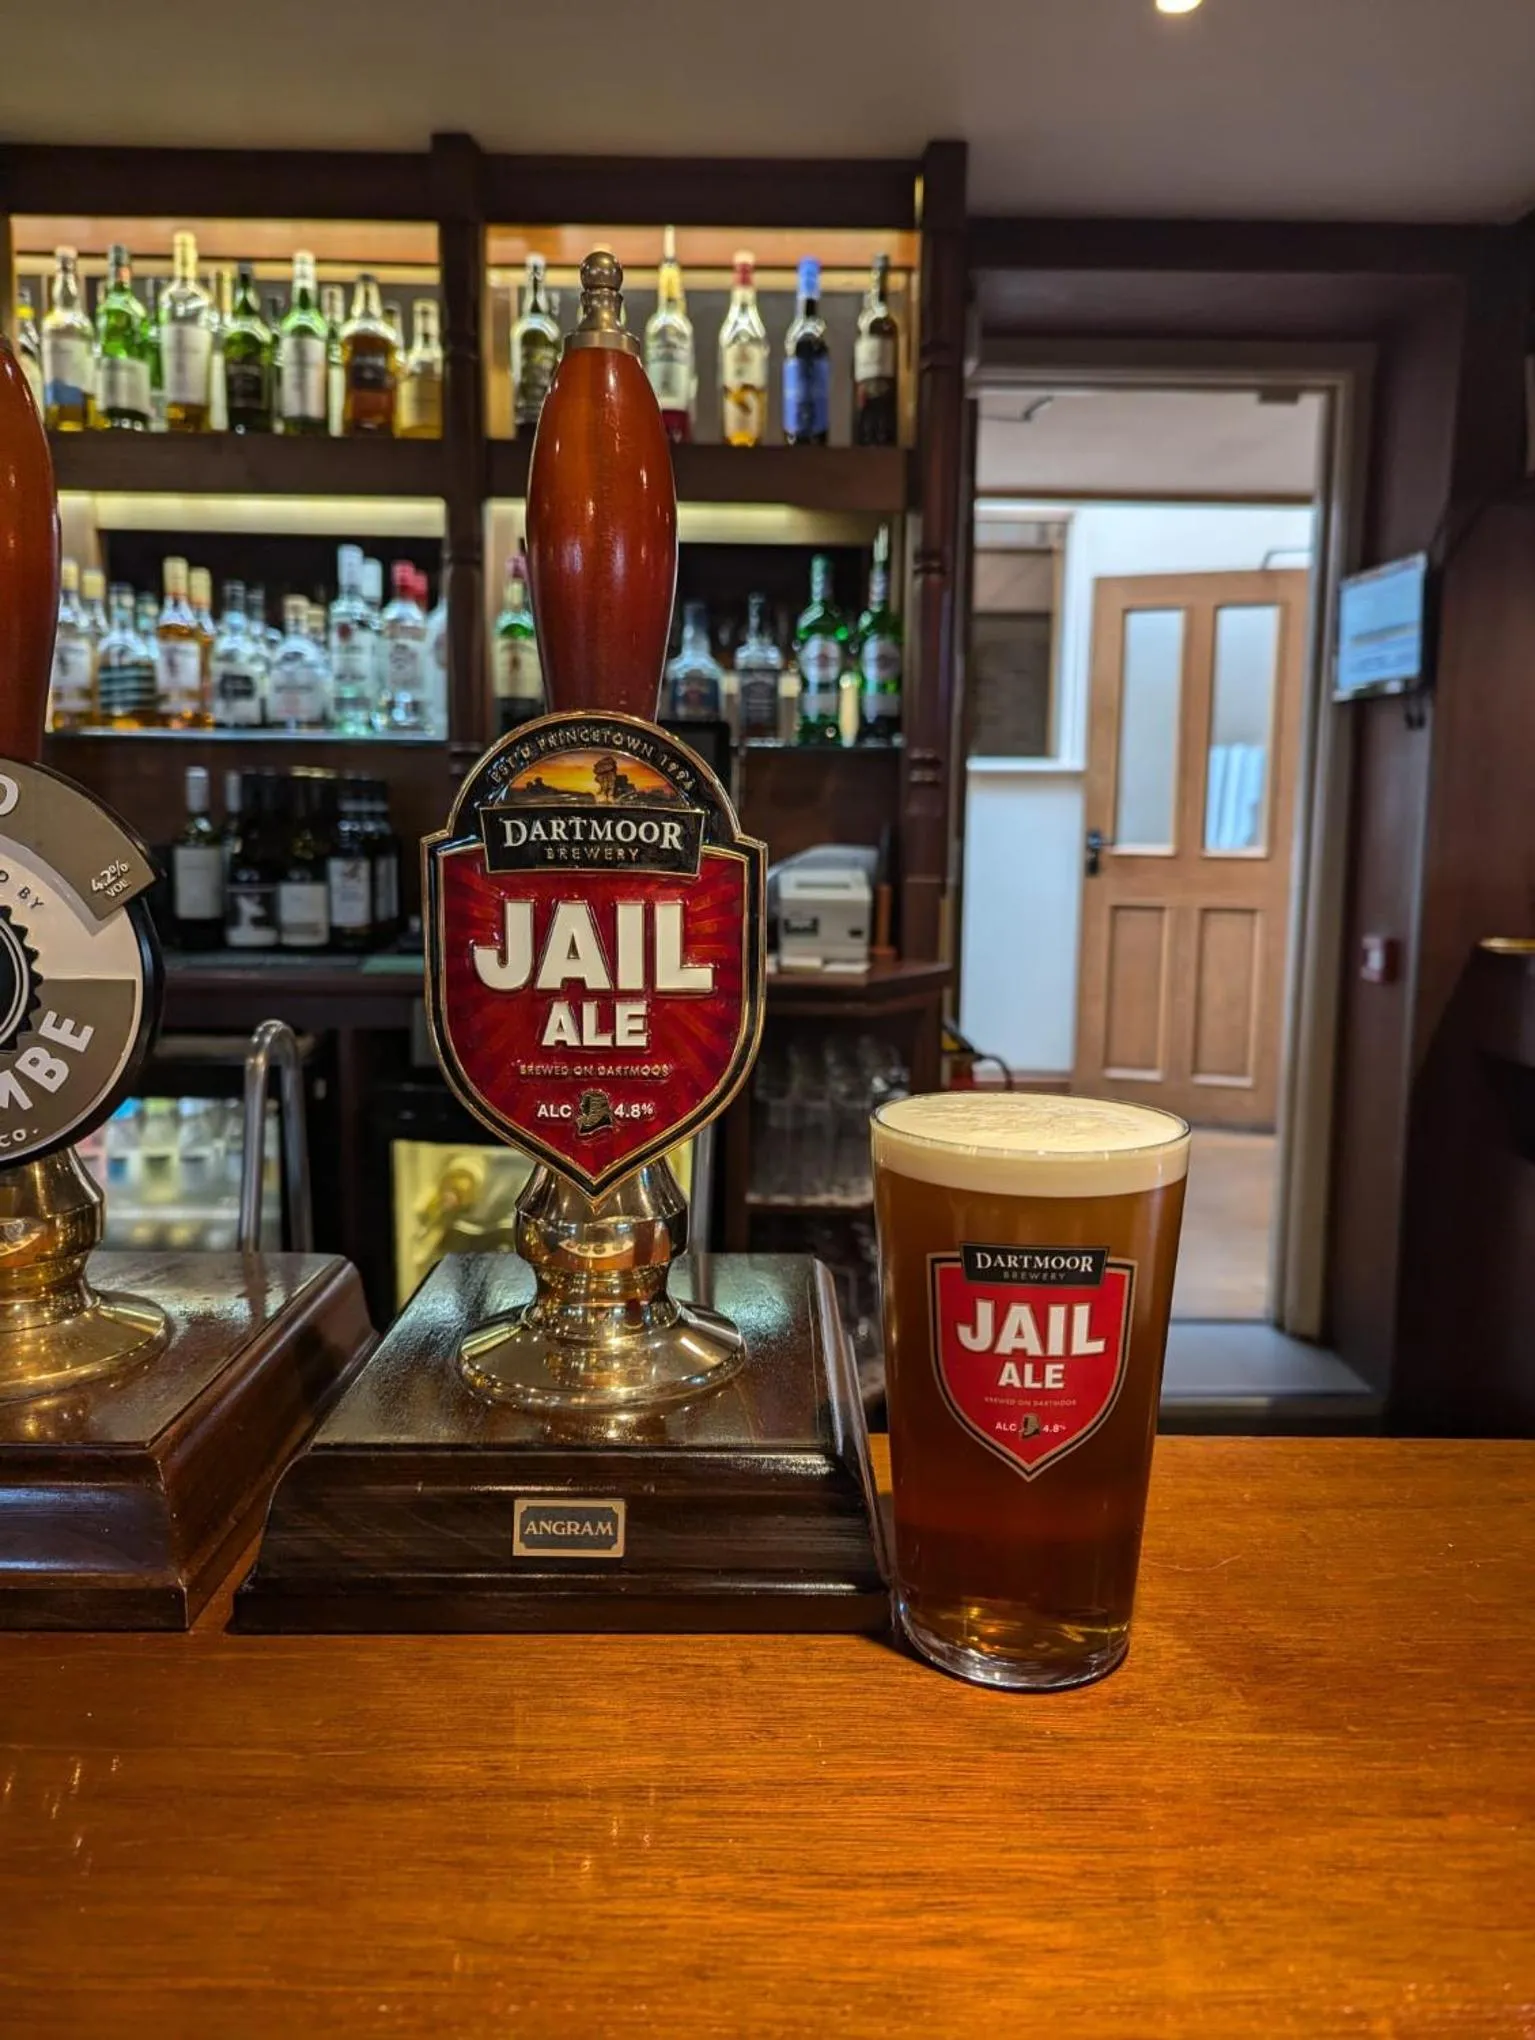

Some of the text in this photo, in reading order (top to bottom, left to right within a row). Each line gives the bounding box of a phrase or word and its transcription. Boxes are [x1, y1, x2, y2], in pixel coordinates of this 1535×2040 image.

[537, 728, 654, 757] PRINCETOWN
[503, 819, 683, 850] DARTMOOR
[546, 847, 639, 861] BREWERY
[91, 860, 129, 891] 4.2%
[18, 886, 44, 910] BY
[473, 900, 715, 993] JAIL
[541, 1002, 648, 1047] ALE
[519, 1063, 569, 1076] BREWED
[573, 1065, 594, 1076] ON
[537, 1103, 653, 1118] ALC 4.8%
[975, 1252, 1093, 1272] DARTMOOR
[1003, 1271, 1066, 1281] BREWERY
[957, 1299, 1107, 1357] JAIL
[998, 1363, 1065, 1389] ALE
[995, 1422, 1017, 1432] ALC
[524, 1521, 614, 1536] ANGRAM
